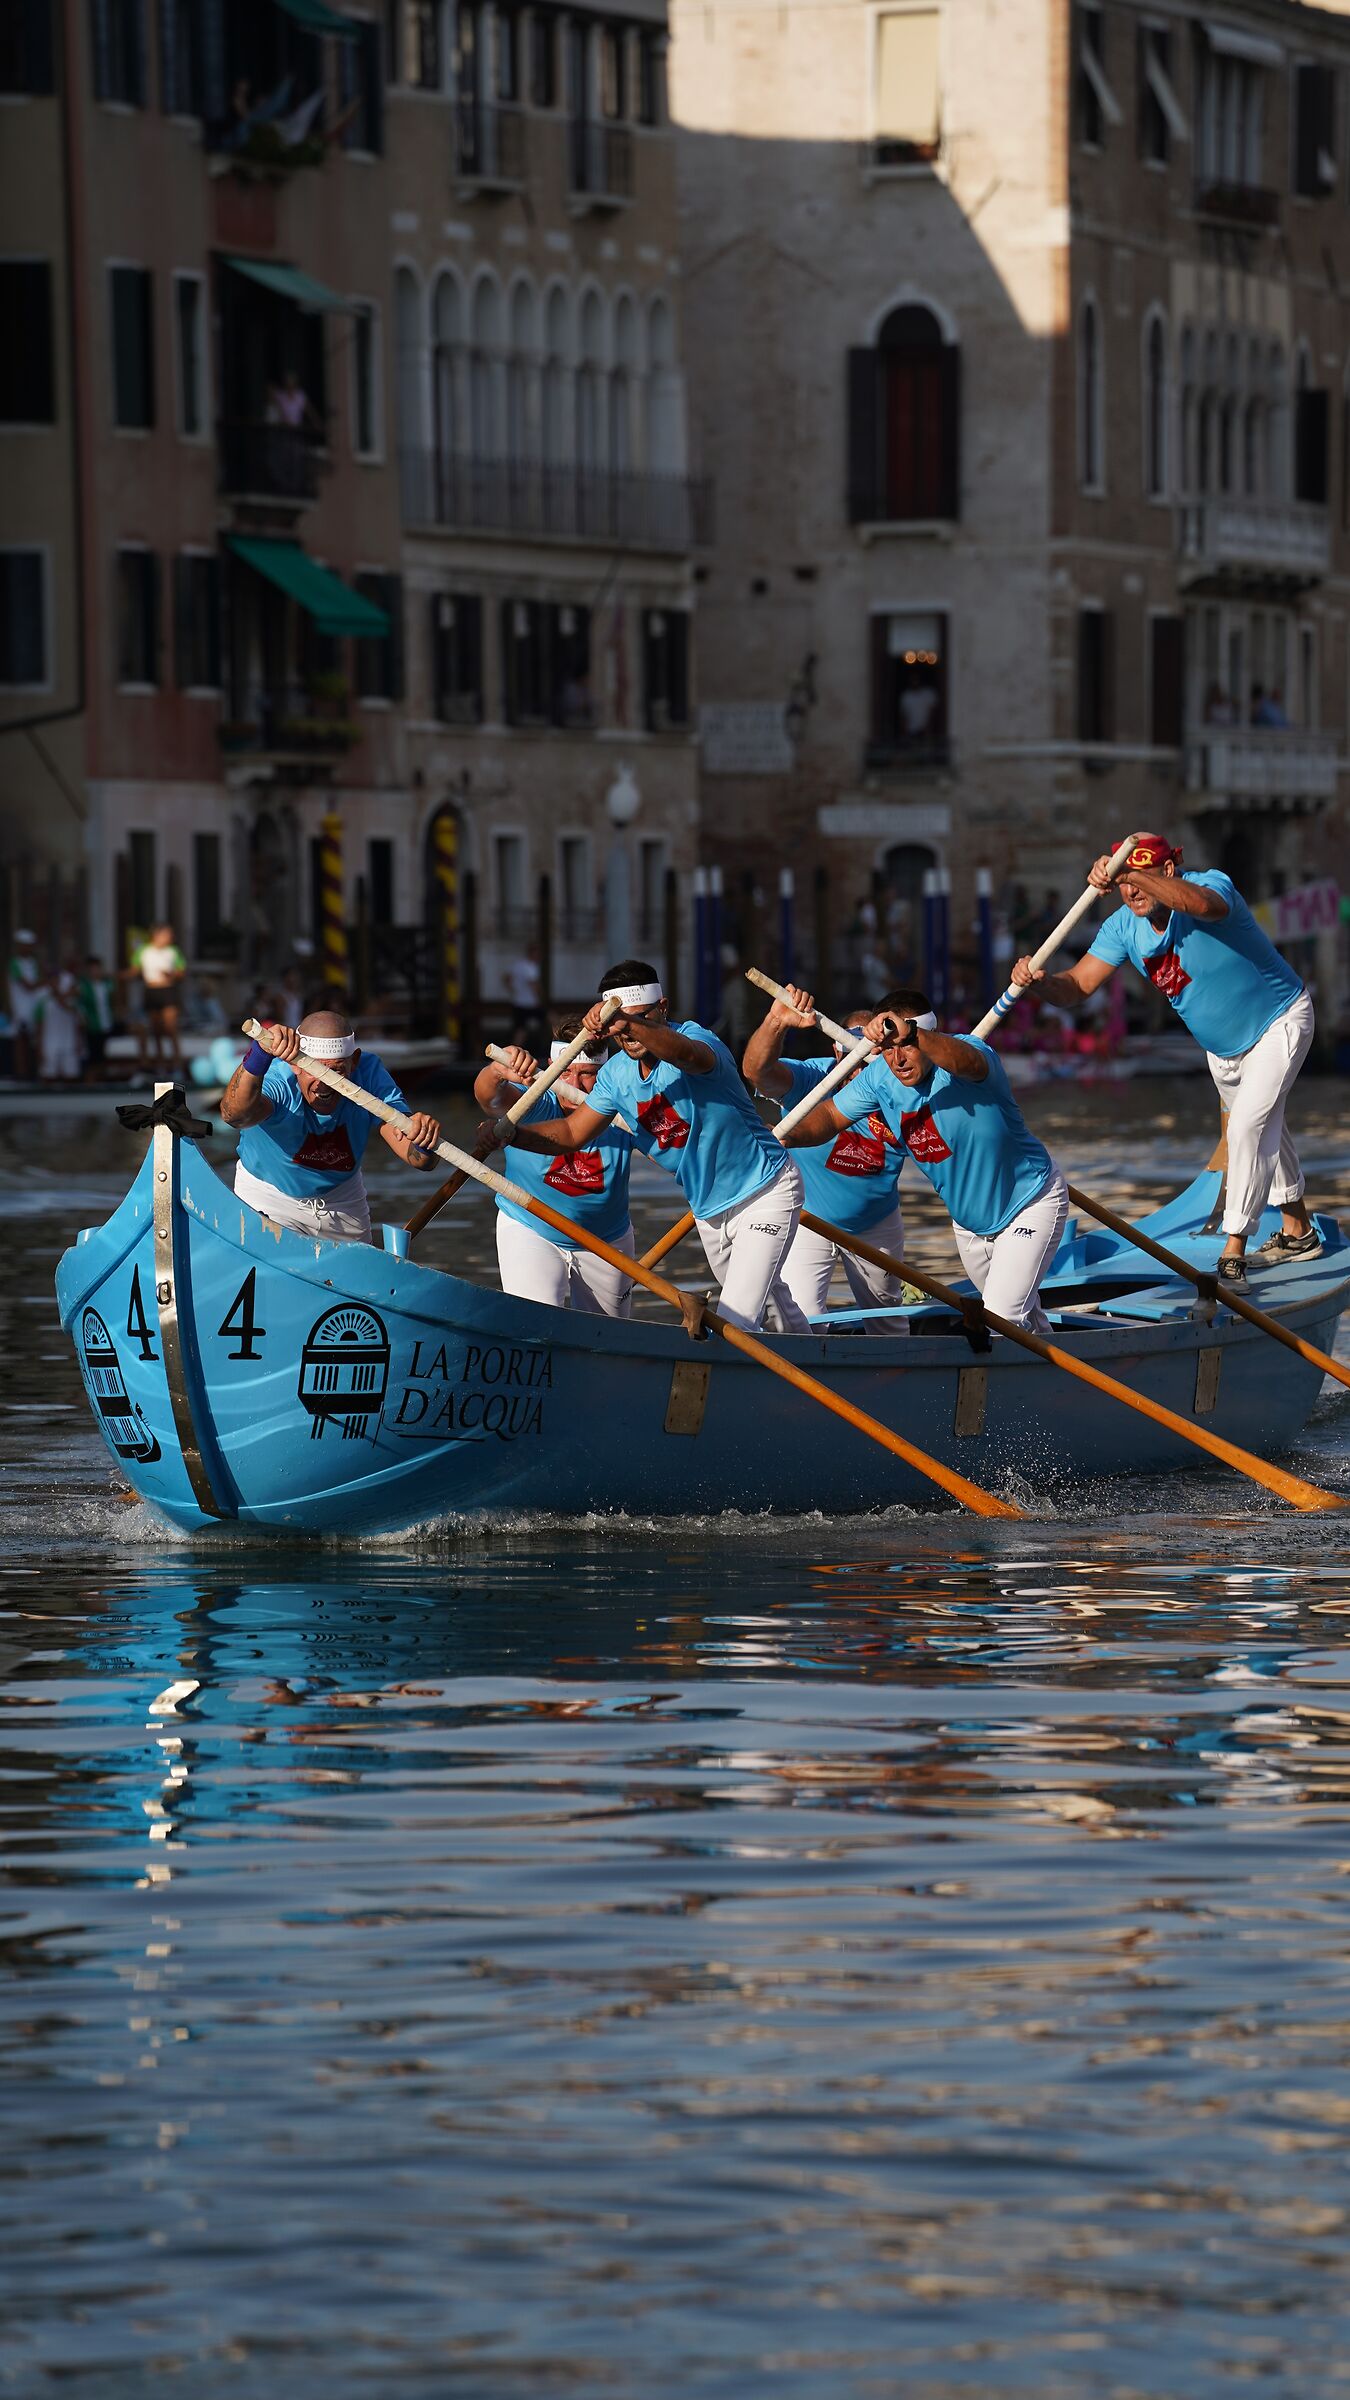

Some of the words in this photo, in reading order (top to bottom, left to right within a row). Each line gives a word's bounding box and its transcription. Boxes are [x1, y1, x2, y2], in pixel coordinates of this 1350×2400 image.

[126, 1263, 160, 1361] 4
[217, 1265, 266, 1360] 4
[407, 1340, 450, 1381] LA
[460, 1344, 554, 1389] PORTA
[392, 1387, 544, 1441] D'ACQUA
